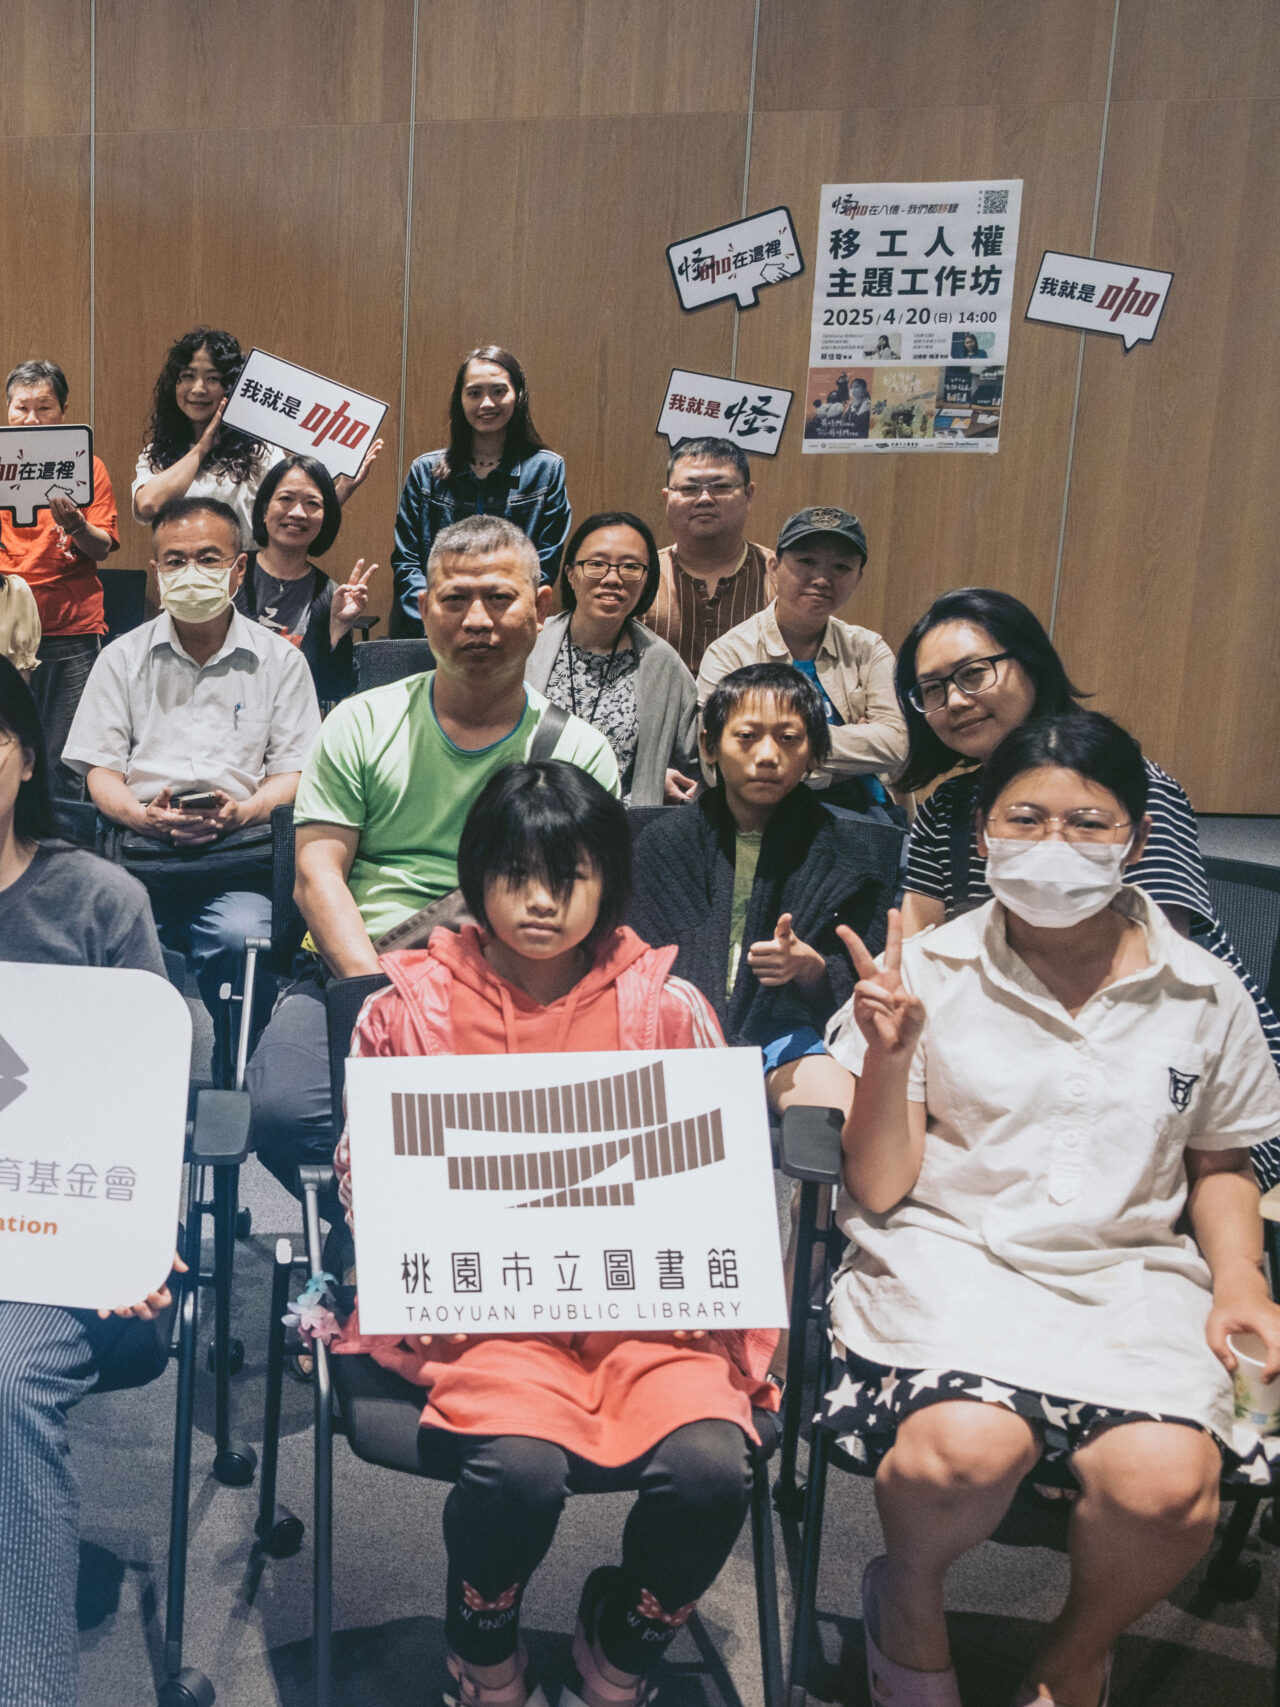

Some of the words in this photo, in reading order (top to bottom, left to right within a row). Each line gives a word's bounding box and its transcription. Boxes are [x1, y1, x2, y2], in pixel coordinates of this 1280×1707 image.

[829, 224, 1006, 260] 移工人權
[826, 264, 1003, 298] 主題工作坊
[958, 311, 997, 324] 14:00
[668, 393, 781, 437] 我就是怪
[401, 1247, 740, 1294] 桃園市立圖書館
[406, 1304, 516, 1323] TAOYUAN
[534, 1303, 620, 1321] PUBLIC
[637, 1300, 742, 1319] LIBRARY
